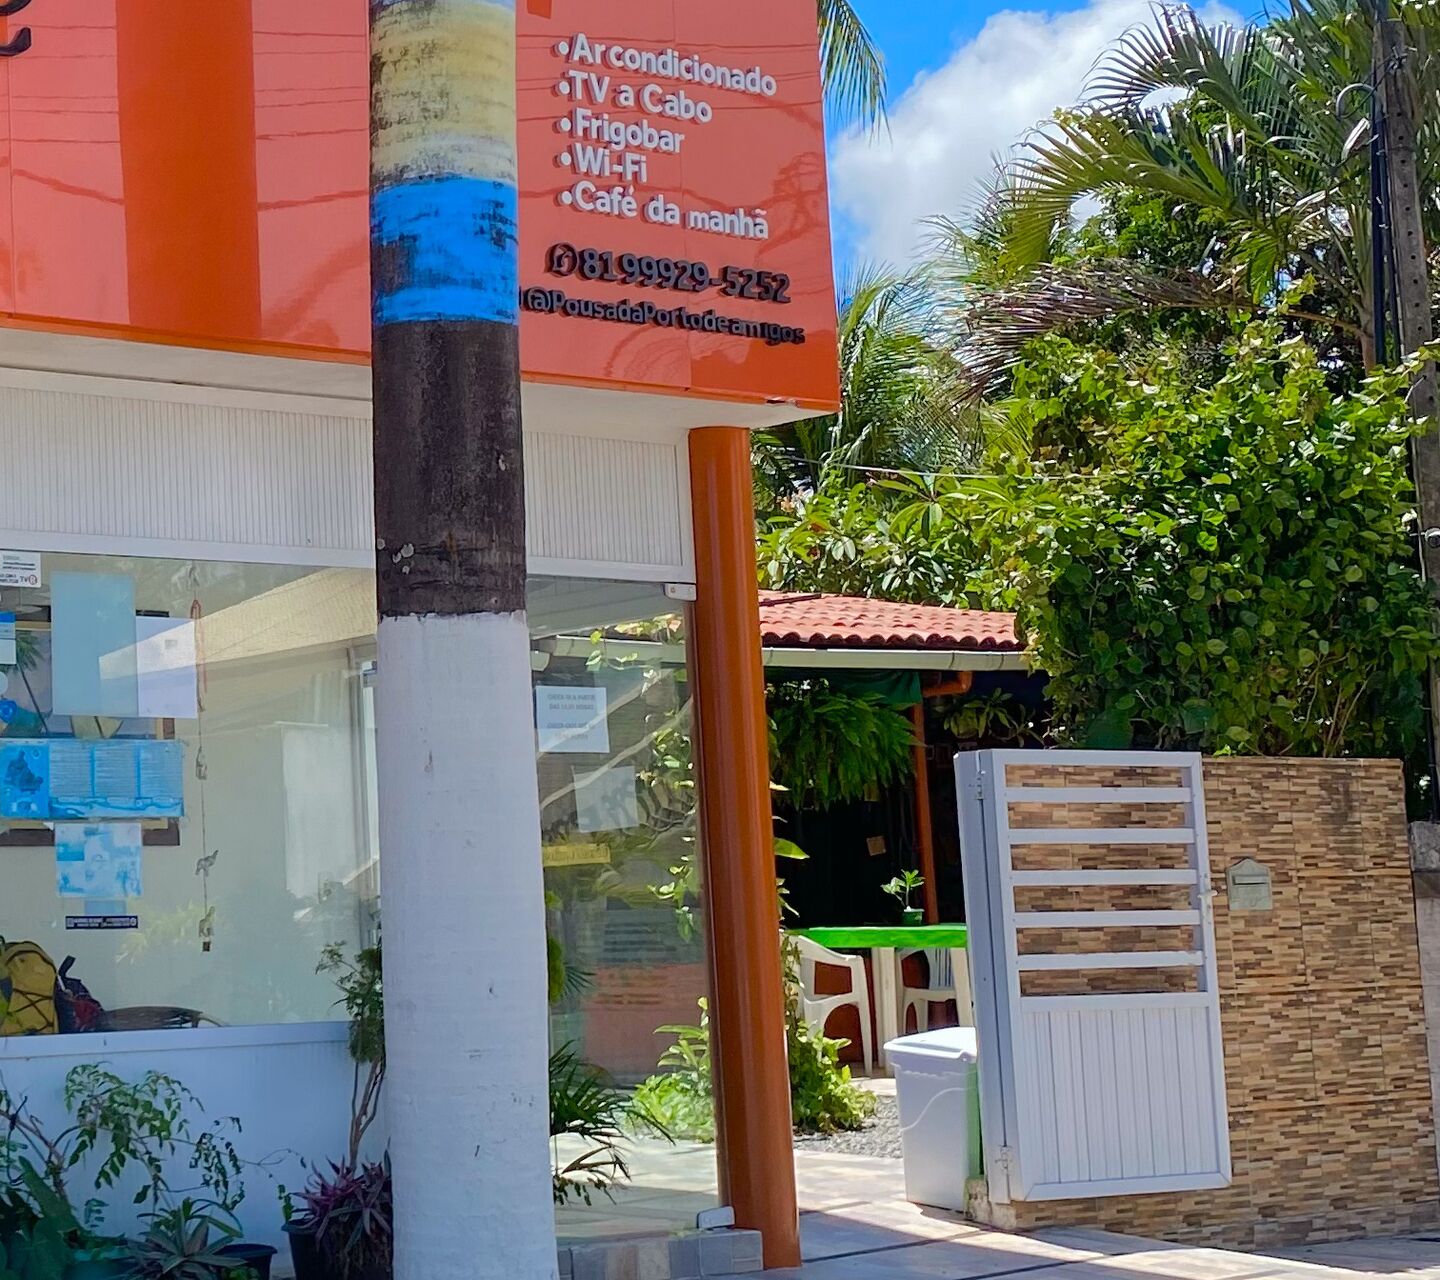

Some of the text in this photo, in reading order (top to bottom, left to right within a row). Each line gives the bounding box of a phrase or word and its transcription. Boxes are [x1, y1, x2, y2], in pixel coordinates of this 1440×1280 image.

[569, 32, 777, 97] Ar condicionado
[568, 69, 713, 124] TV a Cabo
[573, 106, 686, 154] Frigobar
[573, 142, 648, 183] Wi-Fi
[573, 180, 769, 240] Café da manhã
[579, 247, 791, 304] 81 99929-5252
